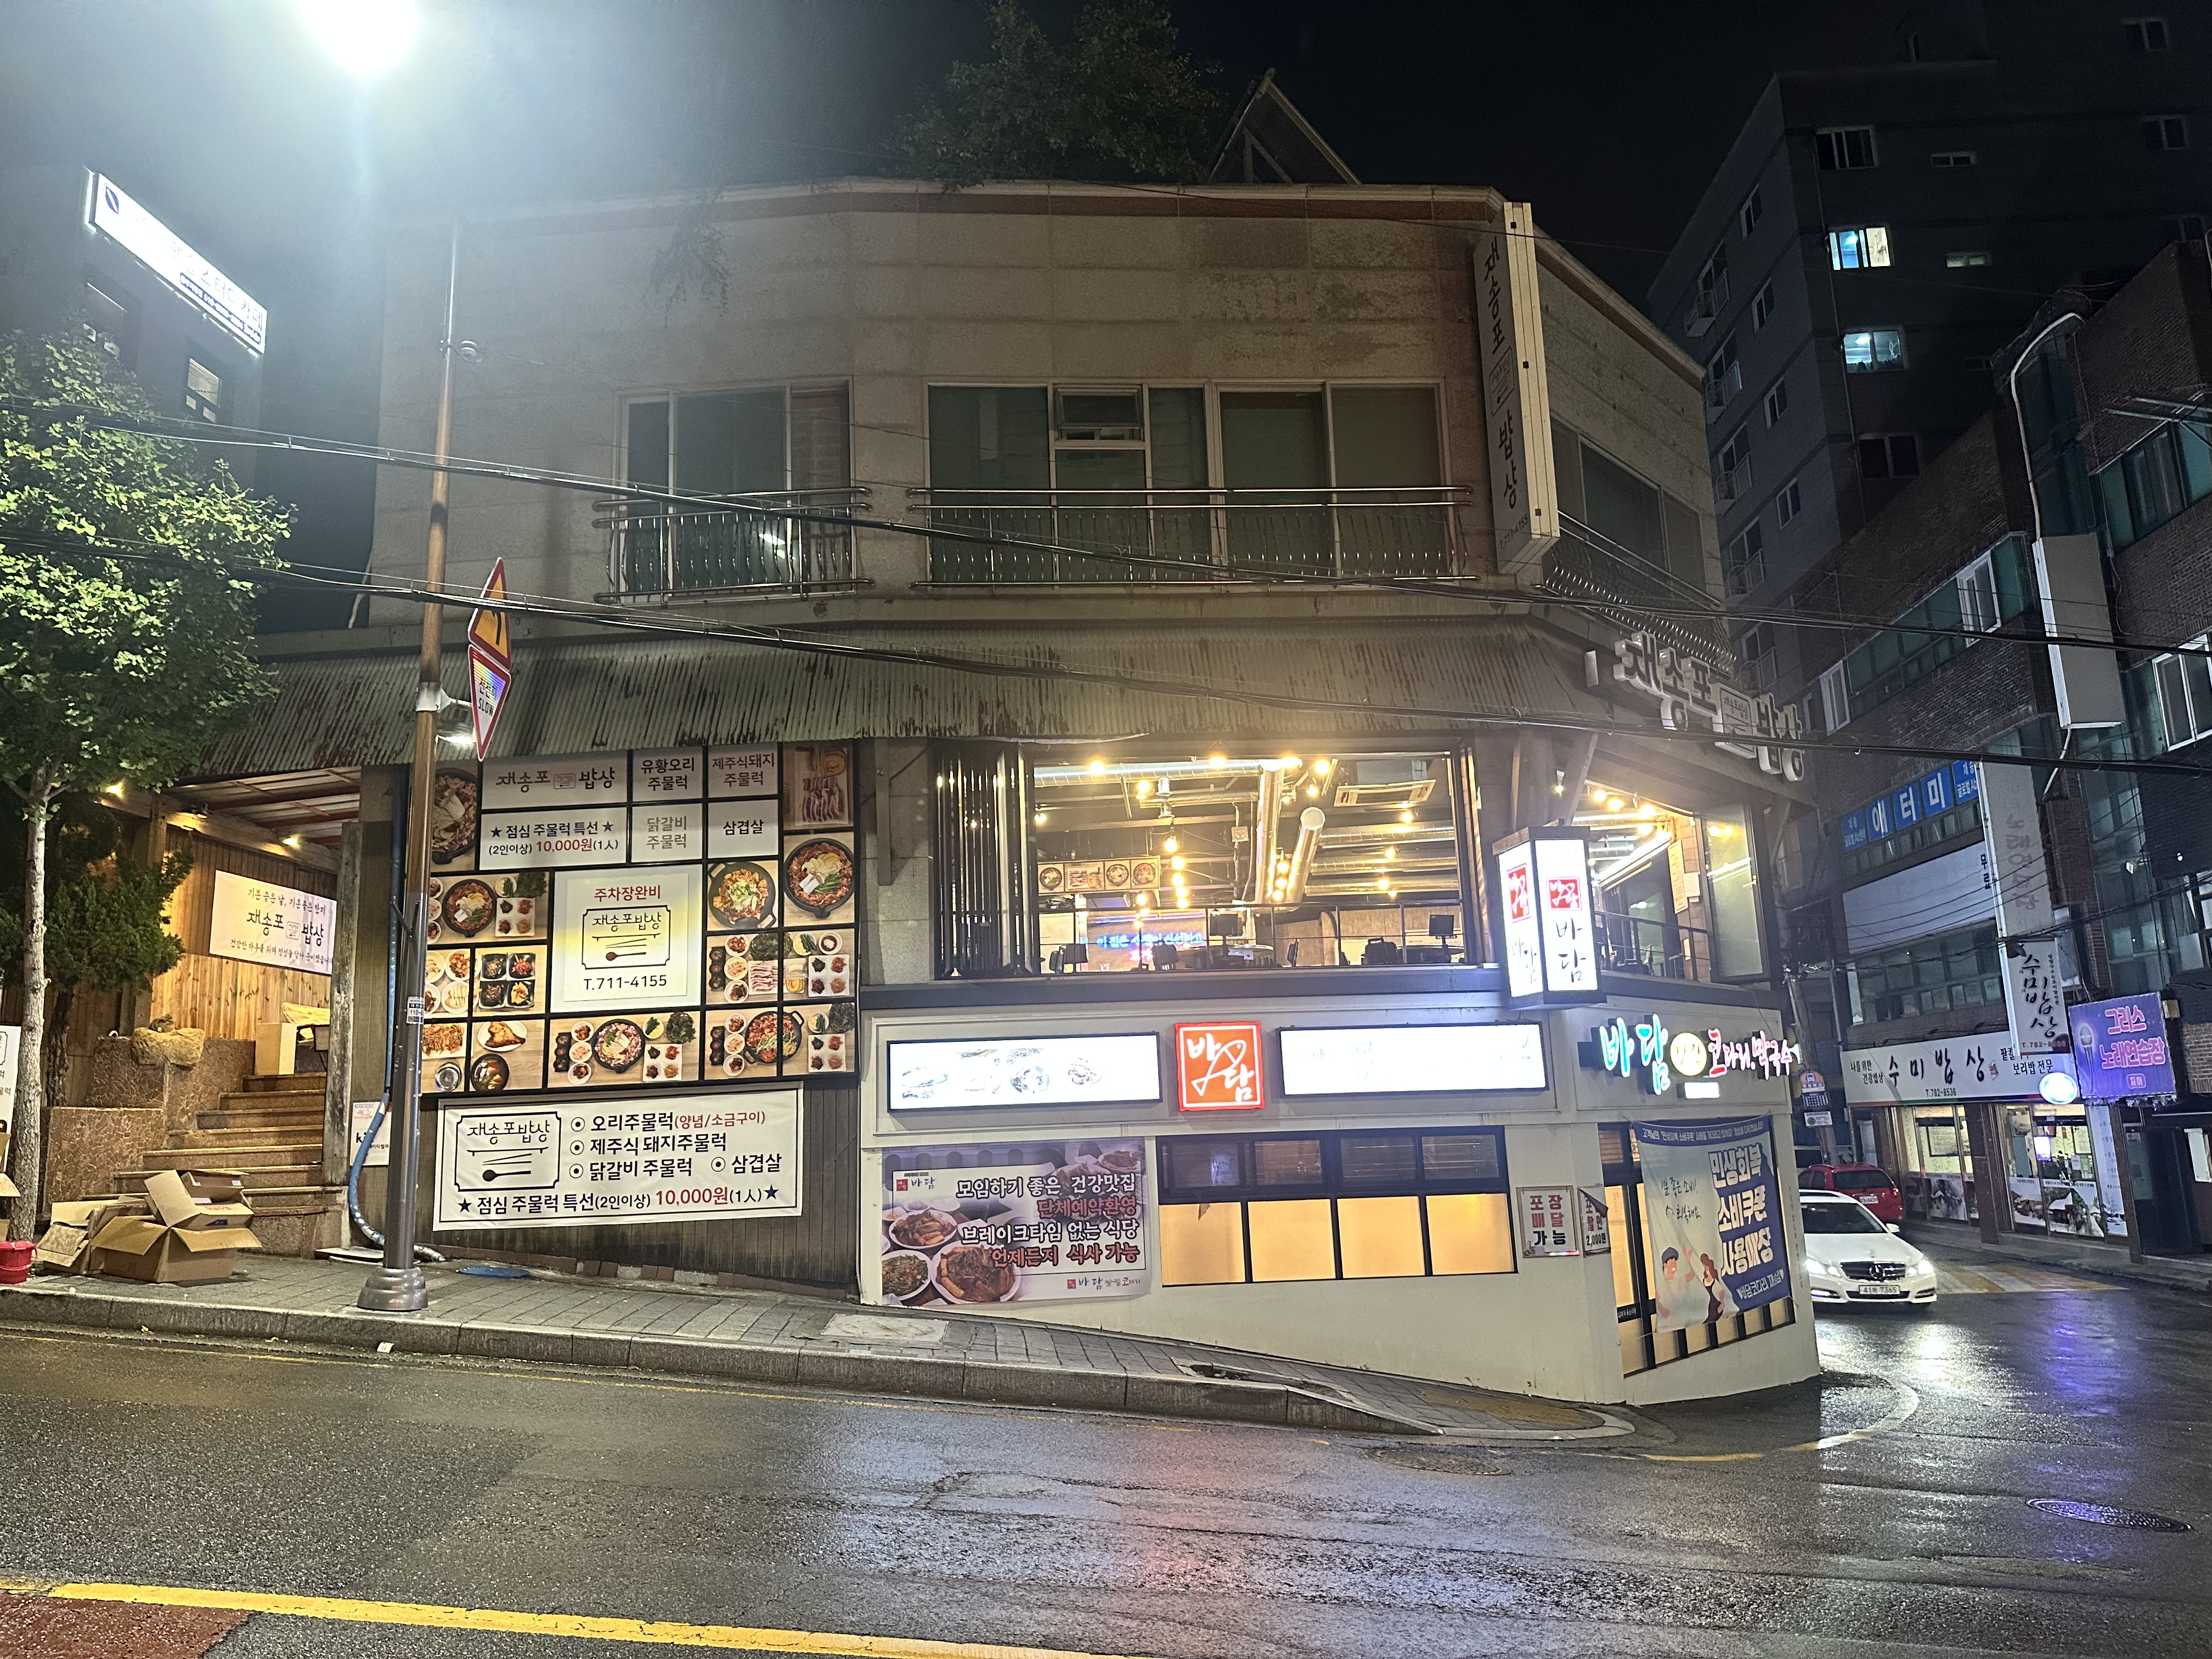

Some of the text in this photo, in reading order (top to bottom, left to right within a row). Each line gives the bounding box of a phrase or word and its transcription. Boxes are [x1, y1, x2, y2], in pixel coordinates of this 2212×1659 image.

[1485, 238, 1505, 355] 재송포
[1499, 409, 1516, 509] 밥상
[478, 697, 494, 718] SLOW
[641, 757, 695, 774] 유황오리
[712, 753, 775, 770] 제주식돼지
[495, 770, 550, 793] 재송포
[578, 767, 615, 790] 밥상
[647, 775, 688, 791] 주물럭
[724, 771, 764, 787] 주물럭
[1871, 772, 1945, 838] 애터미
[506, 821, 599, 839] 점심 주물럭 특선
[647, 815, 687, 832] 닭갈비
[723, 820, 764, 836] 삼겹살
[489, 843, 532, 856] (2인이상)
[646, 833, 687, 850] 주물럭
[248, 888, 261, 900] 기분
[263, 890, 276, 904] 좋은
[289, 897, 301, 909] 기분
[302, 900, 313, 912] 좋은
[594, 885, 661, 902] 주차장완비
[247, 909, 284, 936] 재송포
[302, 922, 324, 947] 밥상
[592, 912, 662, 932] 재송포밥상
[230, 939, 247, 950] 건강한
[249, 942, 264, 953] 하루를
[278, 947, 293, 958] 정성을
[1555, 917, 1587, 984] 바담
[583, 975, 667, 990] T.711-4155
[2104, 1005, 2147, 1035] 그리스
[1599, 1013, 1671, 1096] 바담
[2100, 1036, 2165, 1069] 노래연습장
[1863, 1071, 1883, 1084] 건강밥상
[1888, 1046, 1985, 1088] 수미밥상
[2013, 1061, 2036, 1075] 보리밥
[2037, 1059, 2053, 1074] 전문
[1926, 1087, 1957, 1098] T.782-8536
[466, 1120, 550, 1144] 재송포밥상
[590, 1133, 726, 1156] 제주식 돼지주물럭
[590, 1153, 782, 1181] 닭갈비 주물럭 삼겹살
[1709, 1143, 1762, 1189] 민생회복
[911, 1176, 935, 1190] 바담
[956, 1173, 1136, 1198] 모임하기 좋은 건강맛집
[477, 1197, 507, 1215] 점심
[512, 1194, 558, 1213] 주물럭
[1037, 1197, 1137, 1218] 단체예약환영
[1718, 1185, 1768, 1232] 소비쿠폰
[962, 1218, 1139, 1245] 브레이크타임 없는 식당
[1586, 1233, 1606, 1247] 2,000원
[991, 1243, 1141, 1268] 언제든지 식사 가능
[1721, 1227, 1773, 1277] 사용매장
[1079, 1277, 1103, 1290] 바담
[1122, 1277, 1141, 1286] 코다리
